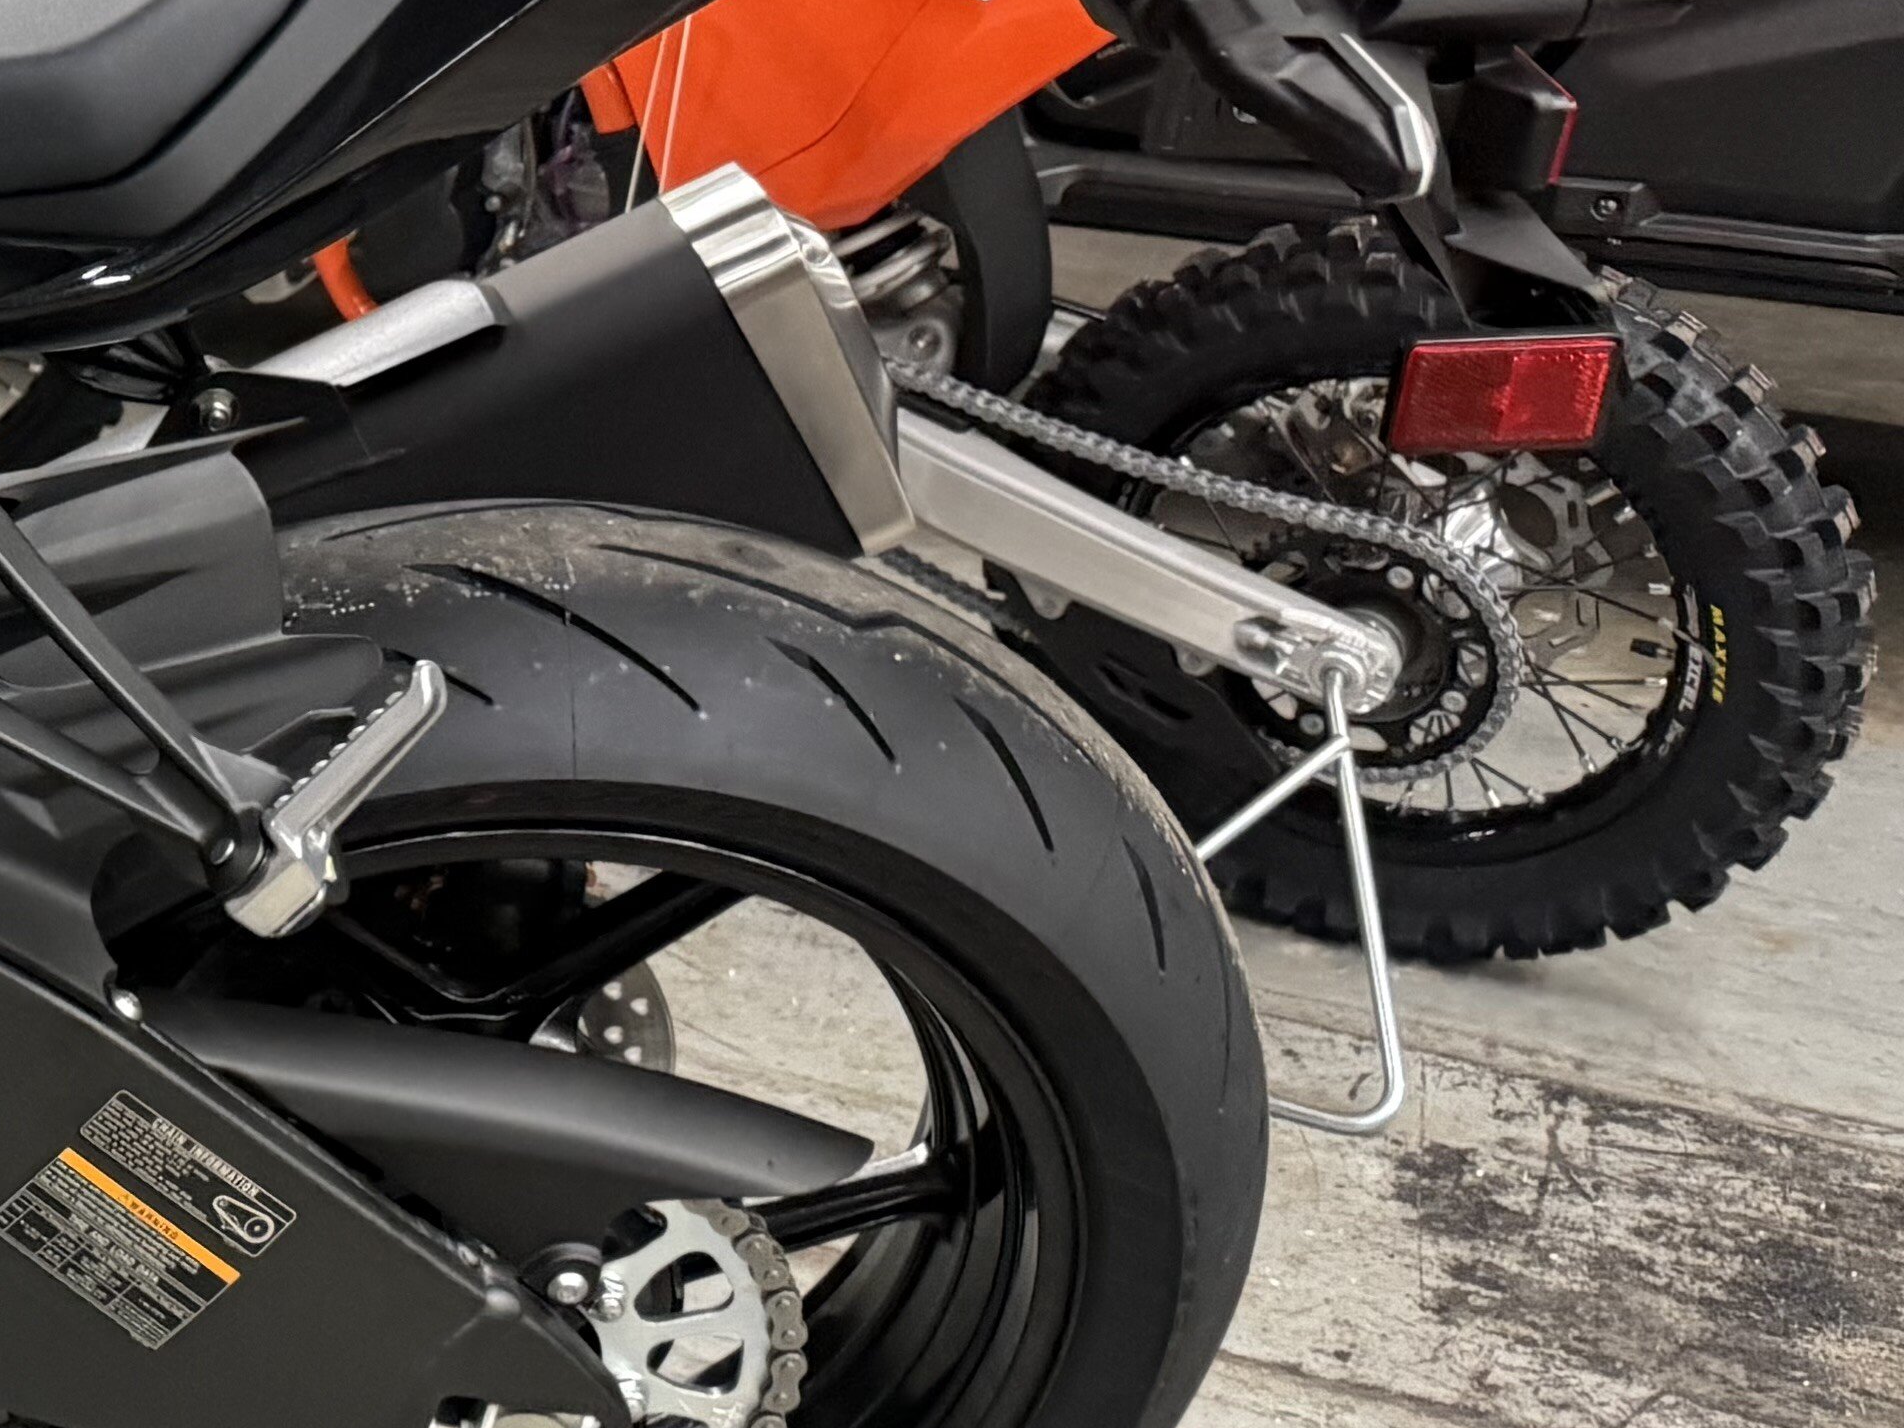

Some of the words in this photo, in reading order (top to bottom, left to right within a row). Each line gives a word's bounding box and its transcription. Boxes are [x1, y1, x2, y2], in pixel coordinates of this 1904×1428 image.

[1709, 603, 1728, 705] MAXXIS
[189, 1143, 261, 1198] INFORMATION
[129, 1200, 179, 1240] WARNING
